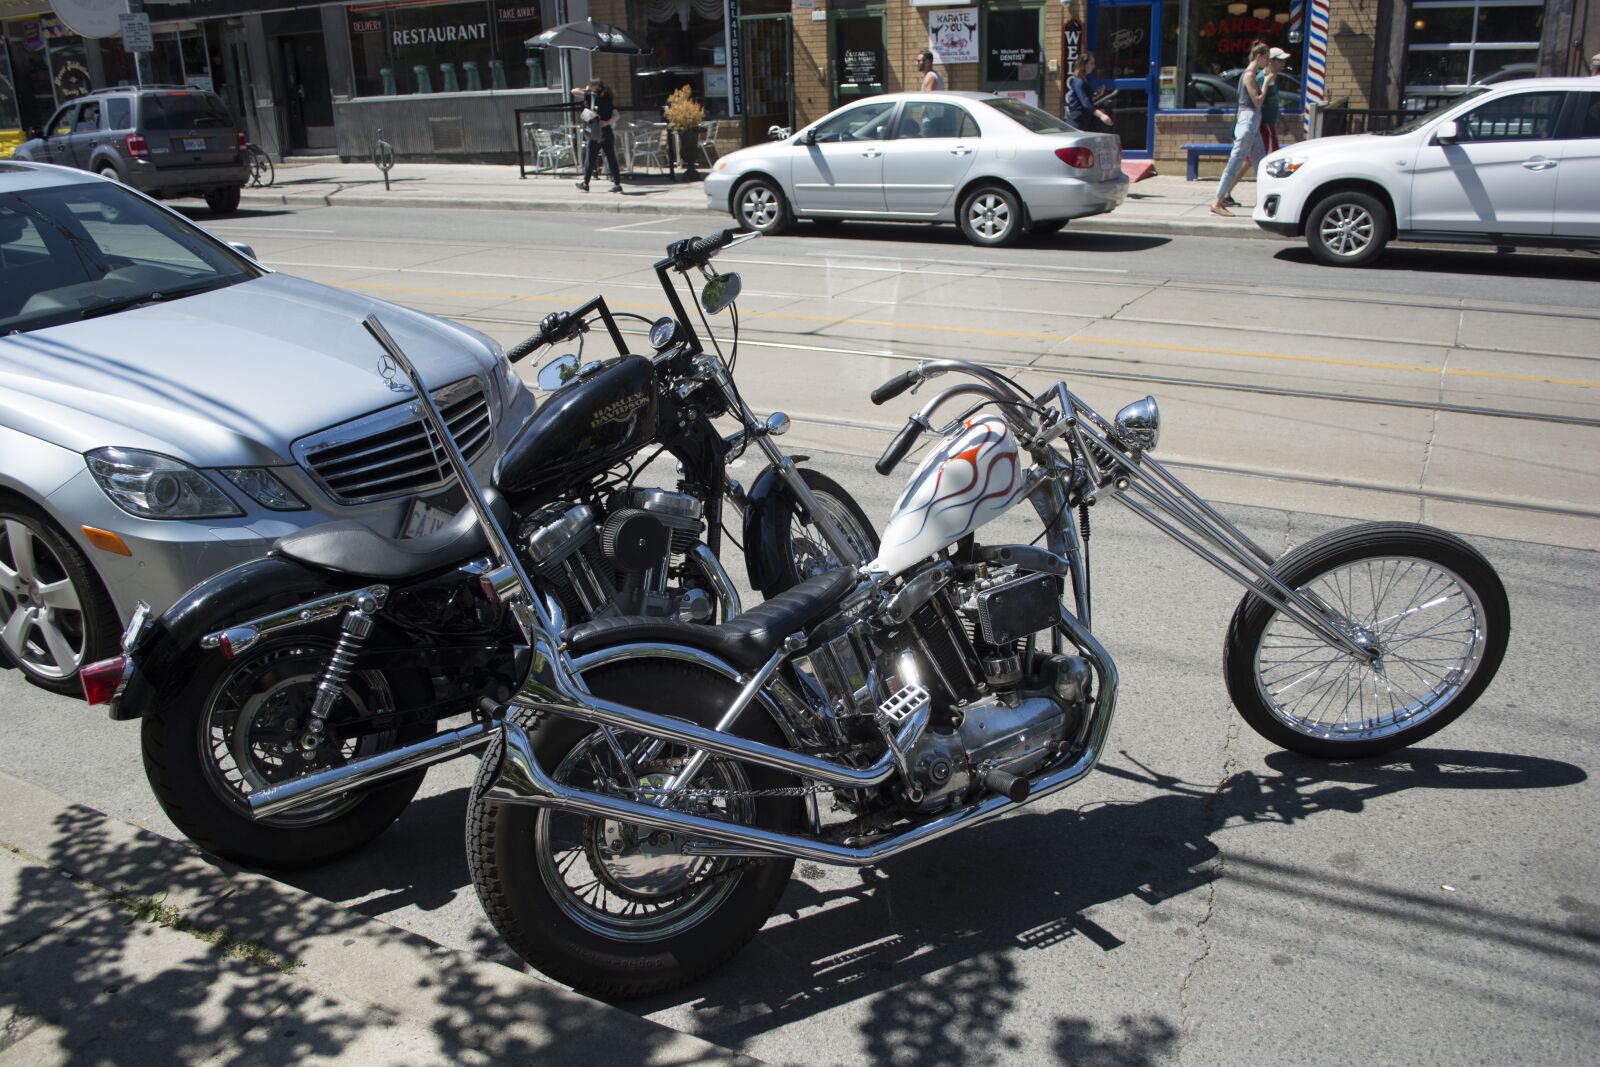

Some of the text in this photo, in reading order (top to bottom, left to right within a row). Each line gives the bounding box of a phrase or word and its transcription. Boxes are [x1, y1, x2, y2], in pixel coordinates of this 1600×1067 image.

[499, 7, 536, 19] TAKE AWAY
[937, 13, 970, 23] KARATE
[352, 20, 381, 32] DELIVERY
[945, 24, 962, 32] YOU
[392, 23, 487, 46] RESTAURANT
[591, 396, 650, 428] DAVIDSON
